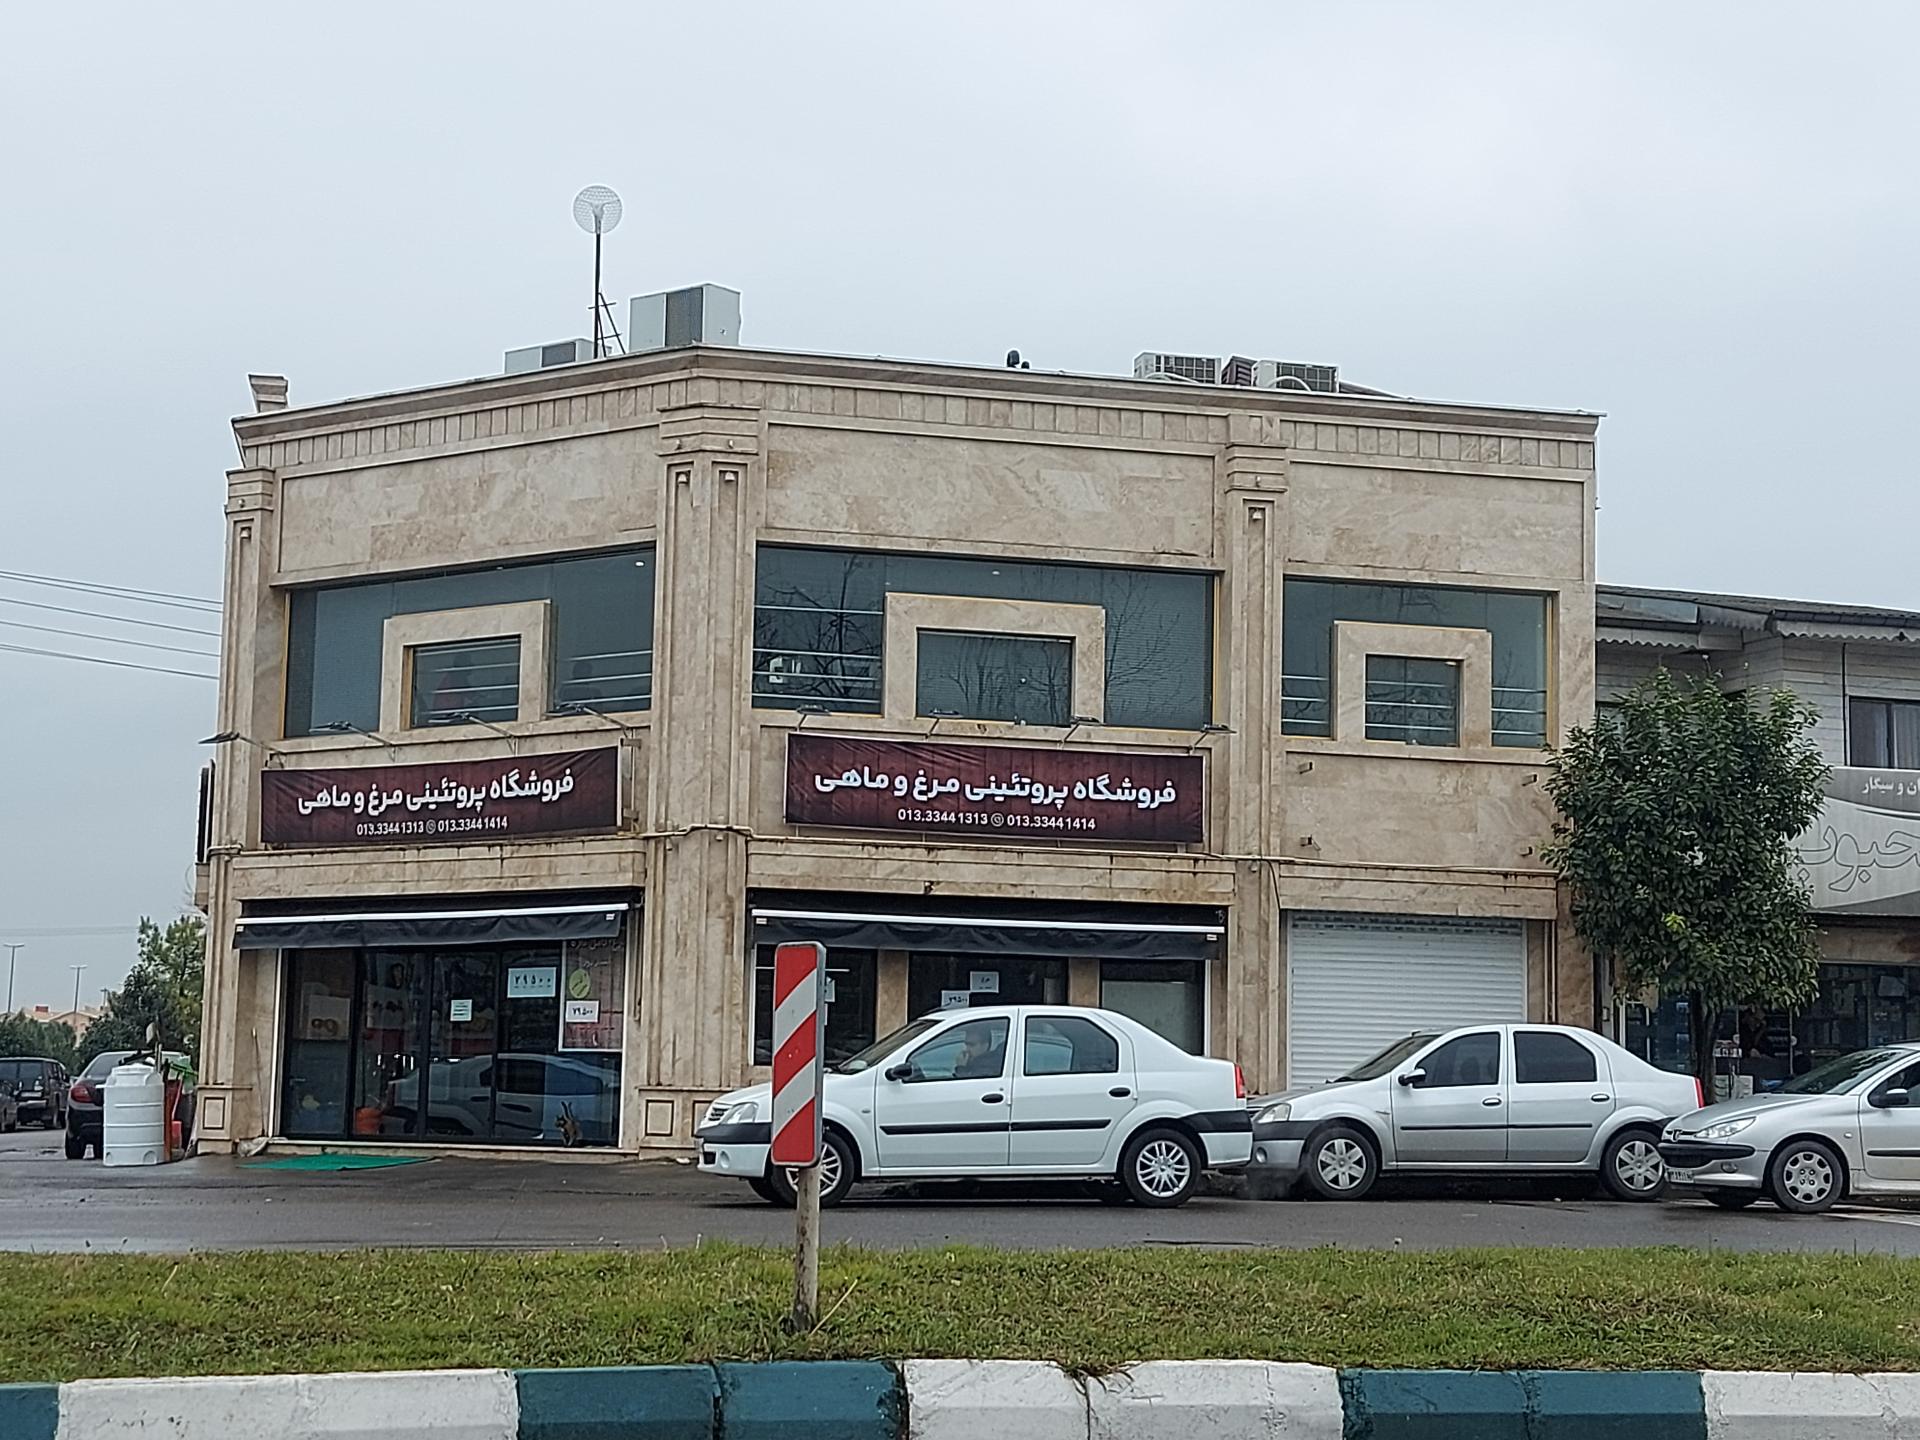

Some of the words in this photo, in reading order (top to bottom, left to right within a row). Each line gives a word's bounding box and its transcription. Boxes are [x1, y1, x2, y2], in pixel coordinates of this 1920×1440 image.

[406, 777, 486, 813] پروتئینی
[489, 767, 574, 802] فروشگاه
[815, 766, 890, 793] ماهی
[894, 775, 908, 797] و
[912, 769, 960, 801] مرغ
[964, 772, 1069, 811] پروتئینی
[1073, 774, 1176, 809] فروشگاه
[298, 784, 351, 815] ماهی
[353, 791, 365, 814] و
[367, 783, 403, 816] مرغ
[898, 808, 988, 825] 013.33441313
[1007, 814, 1096, 830] 013.33441414
